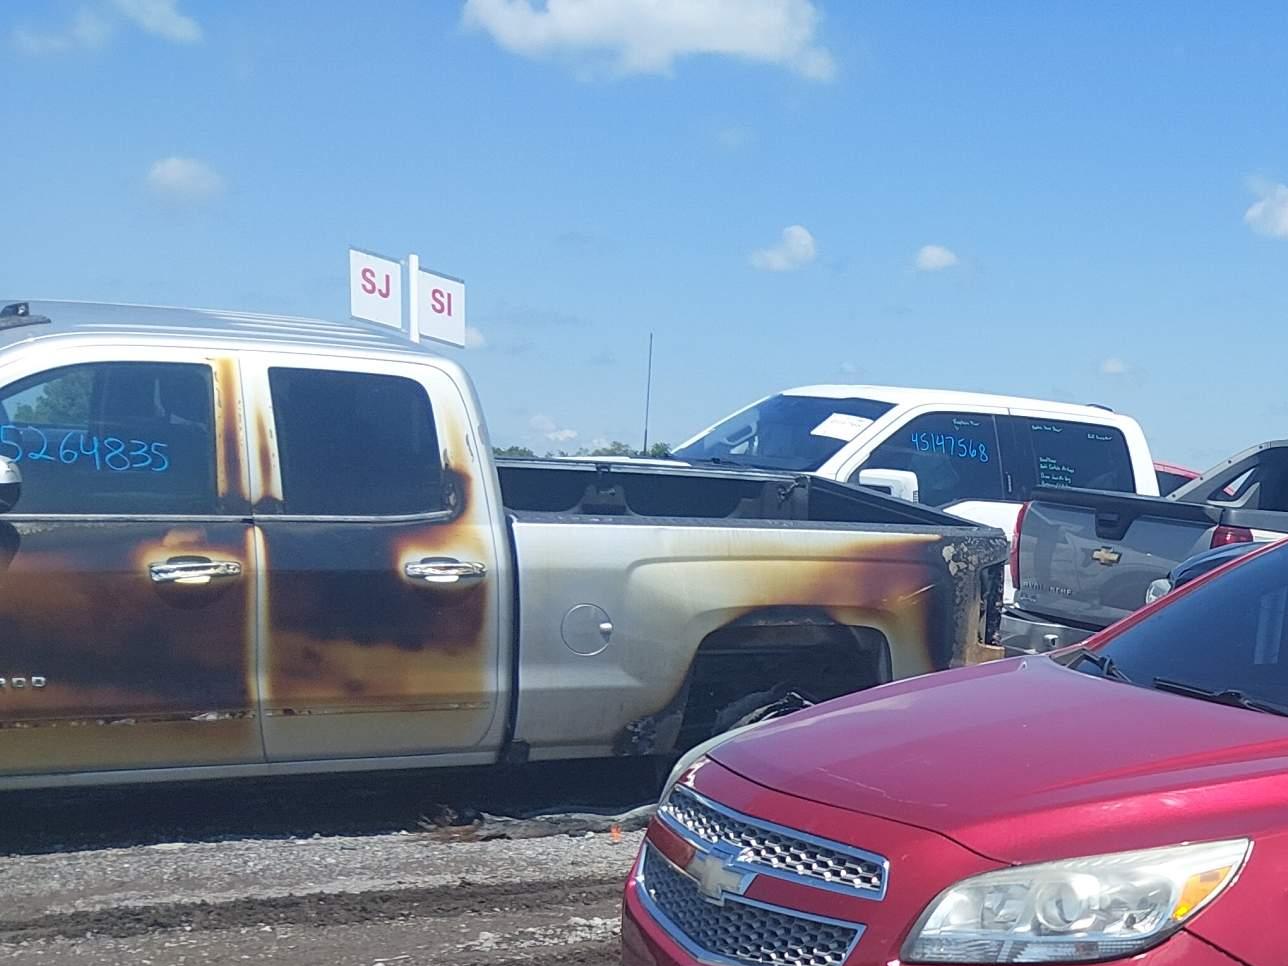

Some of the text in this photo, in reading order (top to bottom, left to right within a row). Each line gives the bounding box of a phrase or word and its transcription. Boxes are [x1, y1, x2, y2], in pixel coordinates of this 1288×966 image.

[361, 267, 391, 298] SJ
[431, 288, 452, 317] SI
[0, 425, 169, 471] 5264835
[911, 432, 989, 463] 45147568
